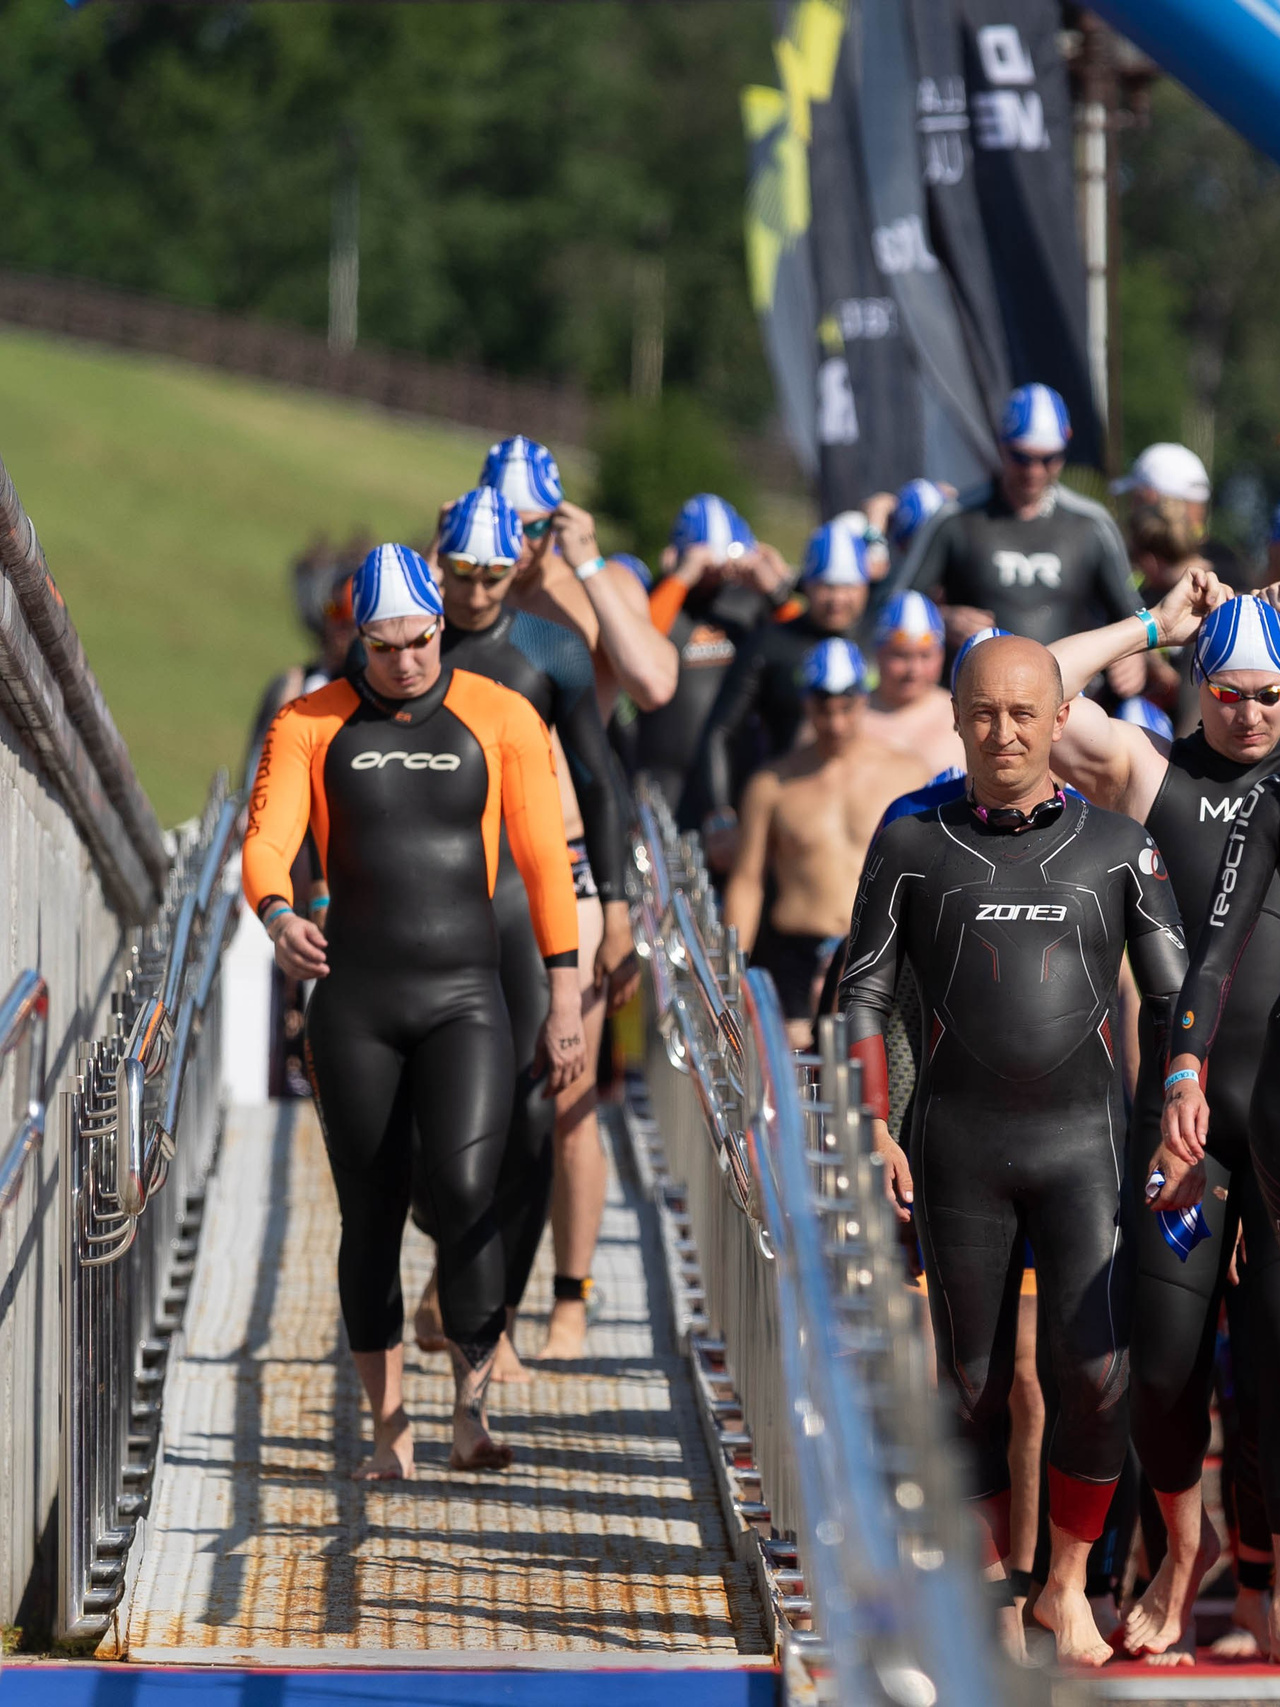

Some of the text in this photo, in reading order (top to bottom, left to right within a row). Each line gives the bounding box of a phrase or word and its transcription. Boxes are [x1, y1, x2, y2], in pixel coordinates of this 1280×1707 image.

[992, 550, 1062, 589] TYR
[350, 750, 461, 771] orca
[1209, 774, 1280, 928] reaction
[975, 904, 1067, 921] ZONE3
